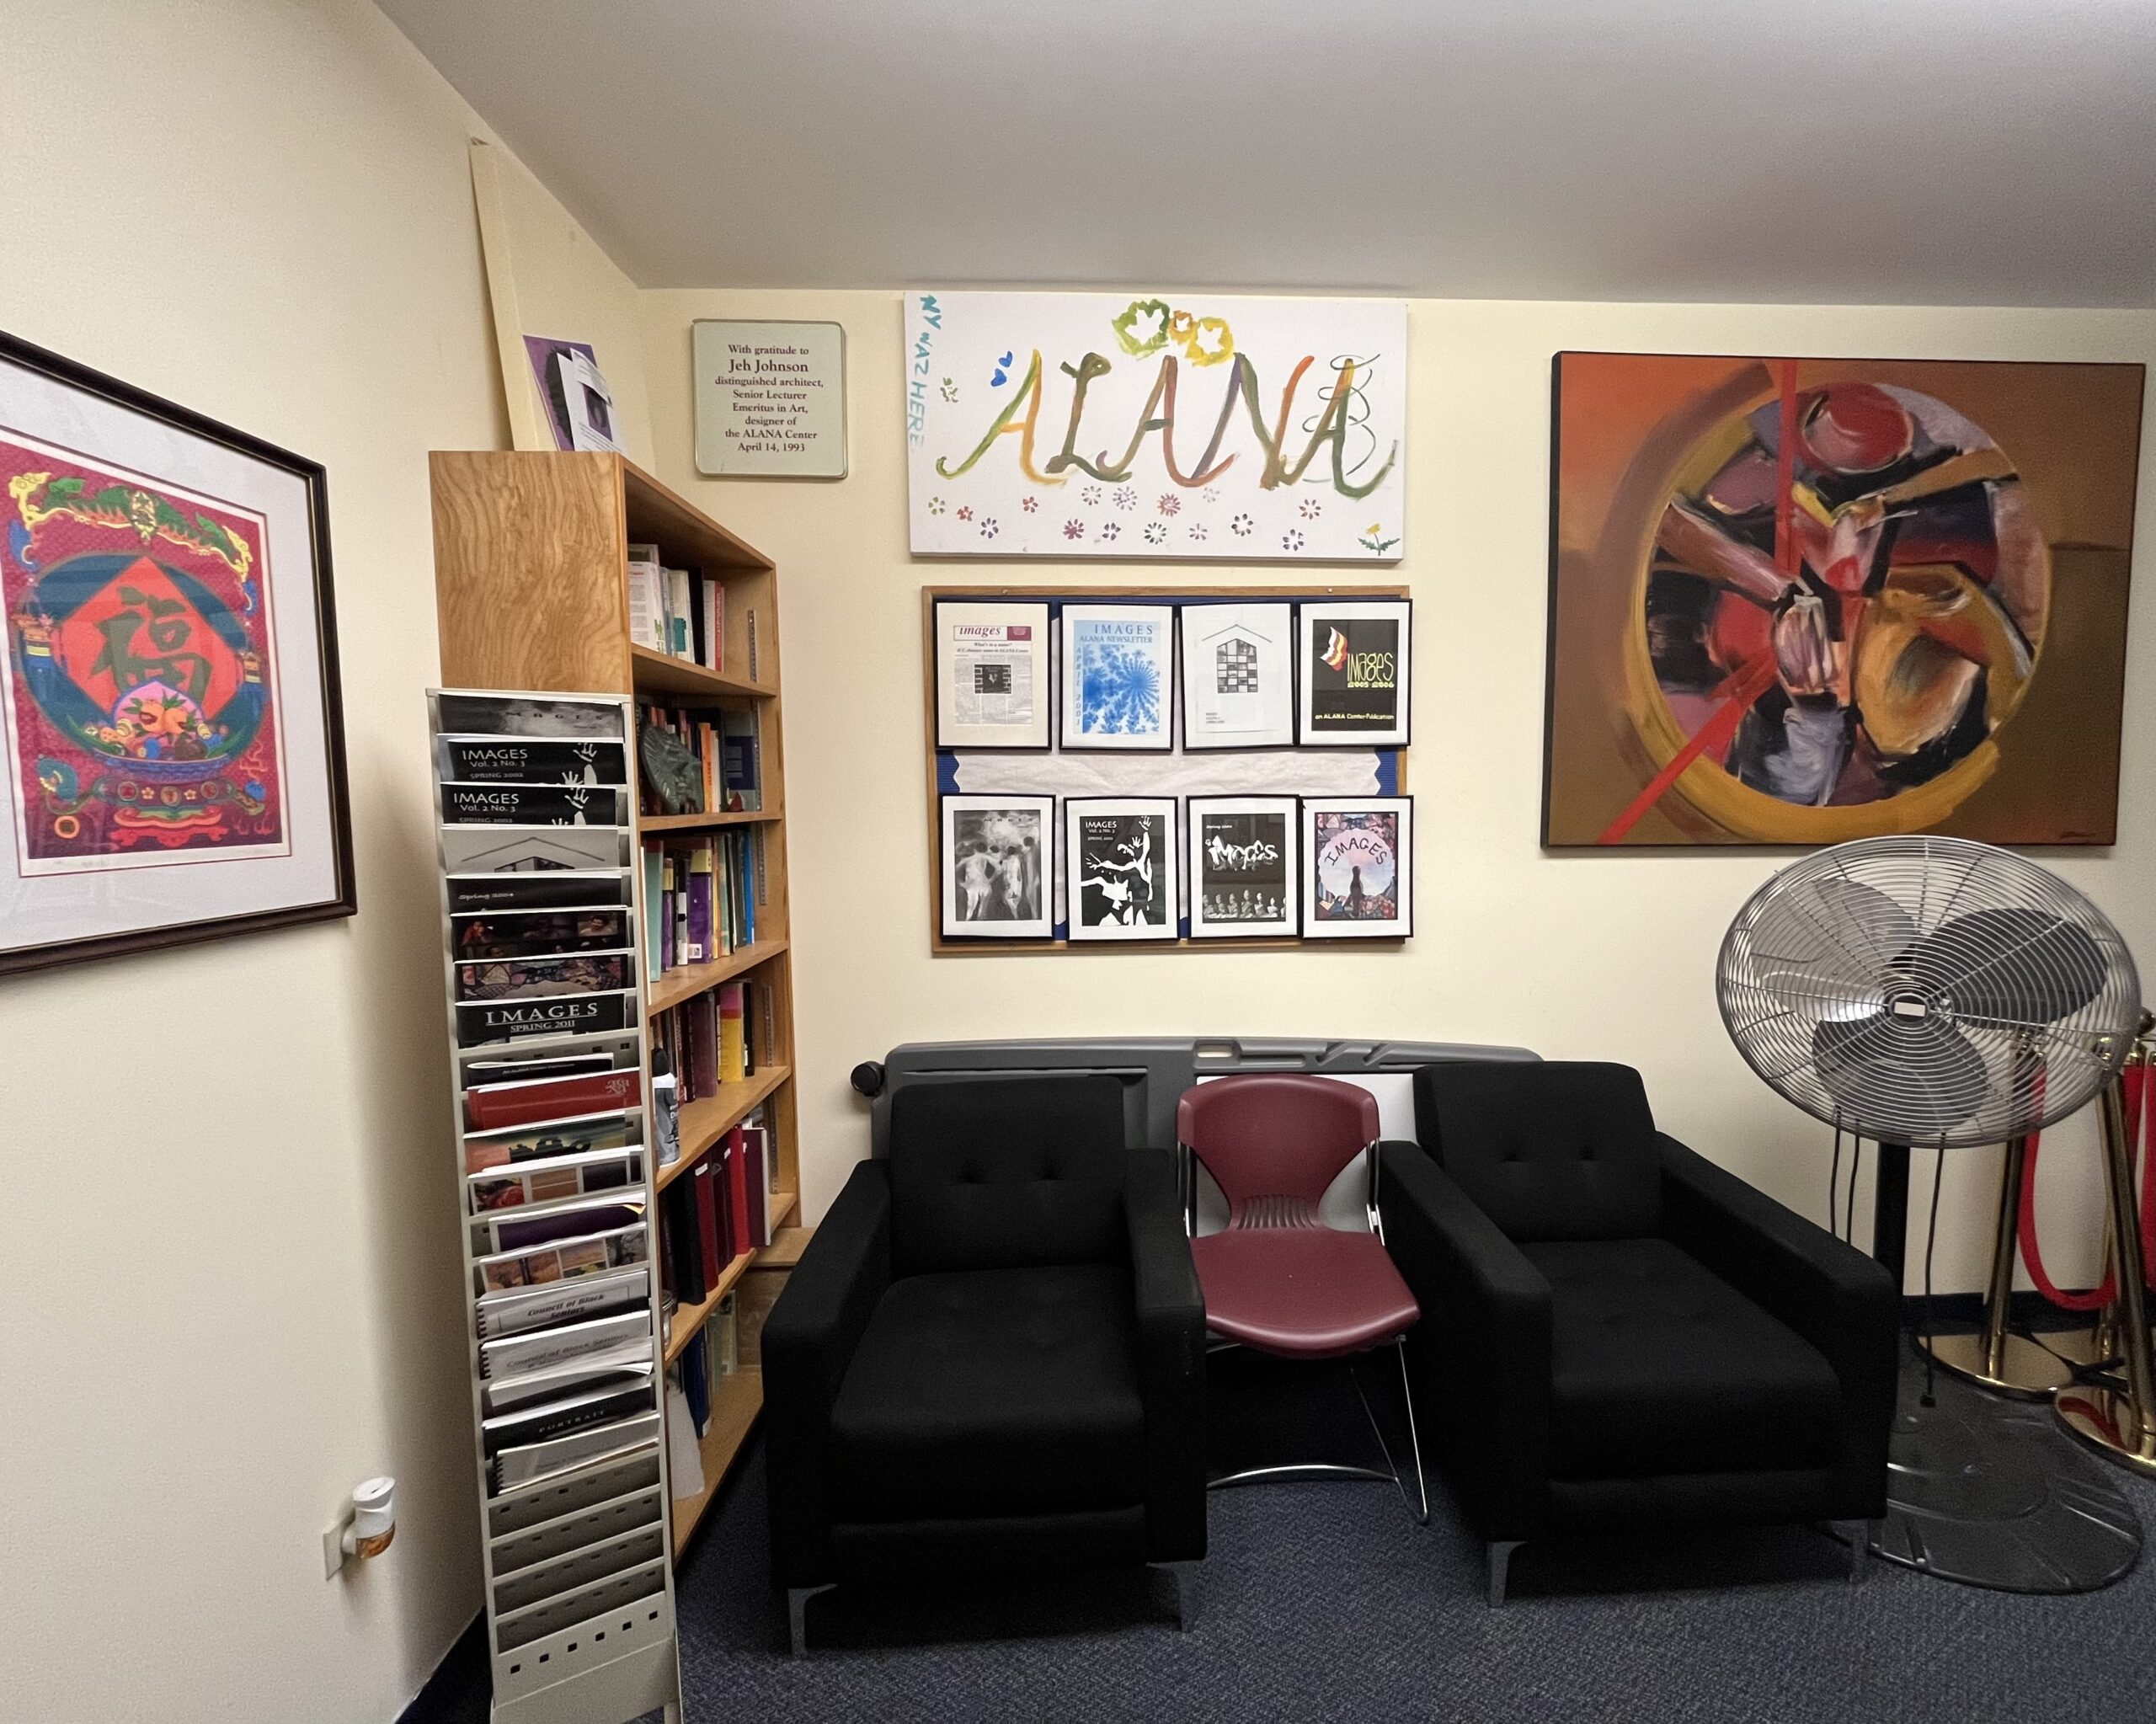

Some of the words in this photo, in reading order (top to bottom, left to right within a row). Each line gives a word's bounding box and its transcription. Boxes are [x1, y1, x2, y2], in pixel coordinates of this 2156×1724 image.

[920, 295, 942, 329] NY
[728, 344, 751, 354] With
[755, 345, 797, 355] gratitude
[728, 360, 750, 373] Jeh
[755, 360, 808, 373] Johnson
[715, 376, 776, 387] distinguished
[780, 379, 824, 387] architect,
[733, 390, 763, 398] Senior
[766, 390, 807, 399] Lecturer
[733, 403, 774, 412] Emeritus
[777, 403, 786, 412] in
[789, 404, 808, 414] Art,
[745, 416, 784, 425] designer
[787, 416, 798, 424] of
[936, 350, 1398, 499] ALANA
[725, 429, 739, 437] the
[743, 430, 782, 438] ALANA
[785, 430, 817, 439] Center
[737, 443, 761, 451] April
[766, 443, 779, 452] 14,
[782, 443, 805, 451] 1993
[1095, 625, 1153, 634] IMAGES
[89, 586, 213, 705] 福
[462, 749, 527, 761] IMAGES
[454, 793, 520, 803] IMAGES
[1324, 837, 1387, 866] IMAGES
[485, 1003, 598, 1024] IMAGES
[510, 1022, 552, 1033] SPRING
[554, 1020, 575, 1028] 2011
[528, 1303, 563, 1317] Council
[566, 1300, 576, 1309] of
[579, 1294, 605, 1305] Black
